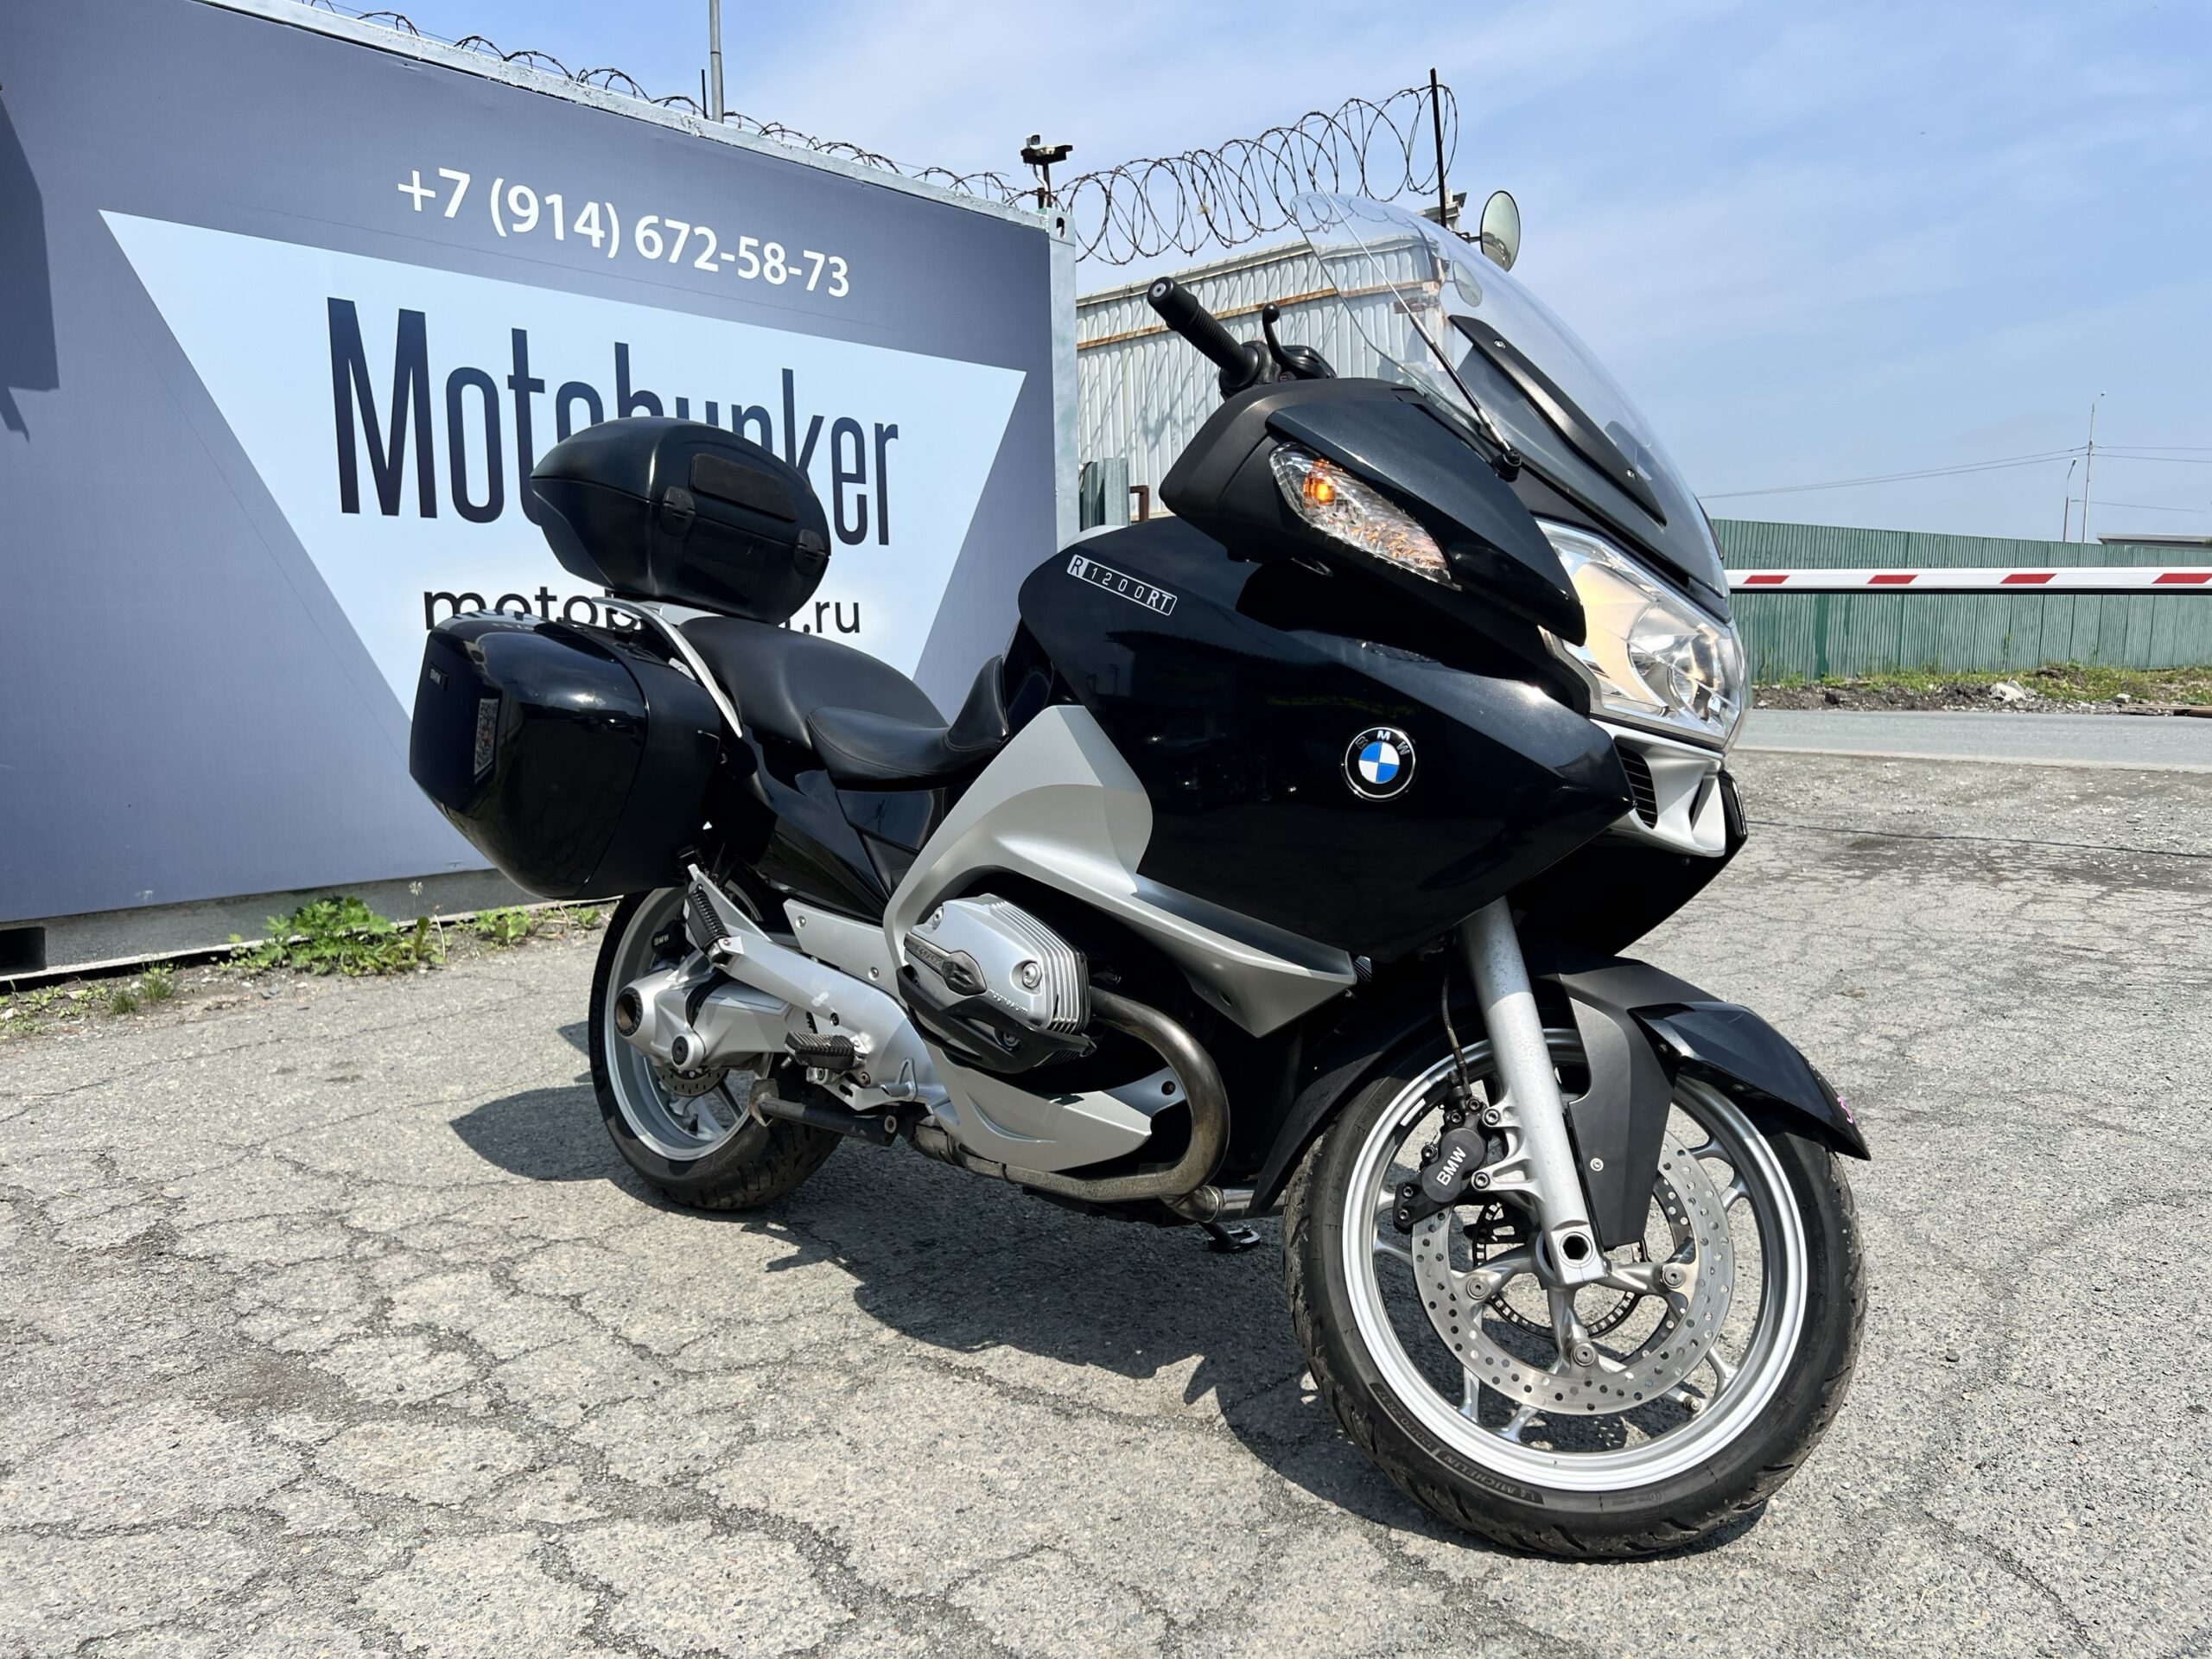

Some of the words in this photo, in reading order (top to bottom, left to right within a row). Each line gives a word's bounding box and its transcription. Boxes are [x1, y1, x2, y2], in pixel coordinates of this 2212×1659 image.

[397, 167, 471, 219] +7
[490, 177, 620, 259] (914)
[634, 214, 849, 297] 672-58-73
[327, 296, 899, 546] Motker
[423, 586, 861, 634] moto.ru
[1355, 729, 1411, 756] BMW
[654, 932, 670, 946] BMW
[1436, 1146, 1466, 1186] BMW
[1444, 1455, 1518, 1495] MICHELIN
